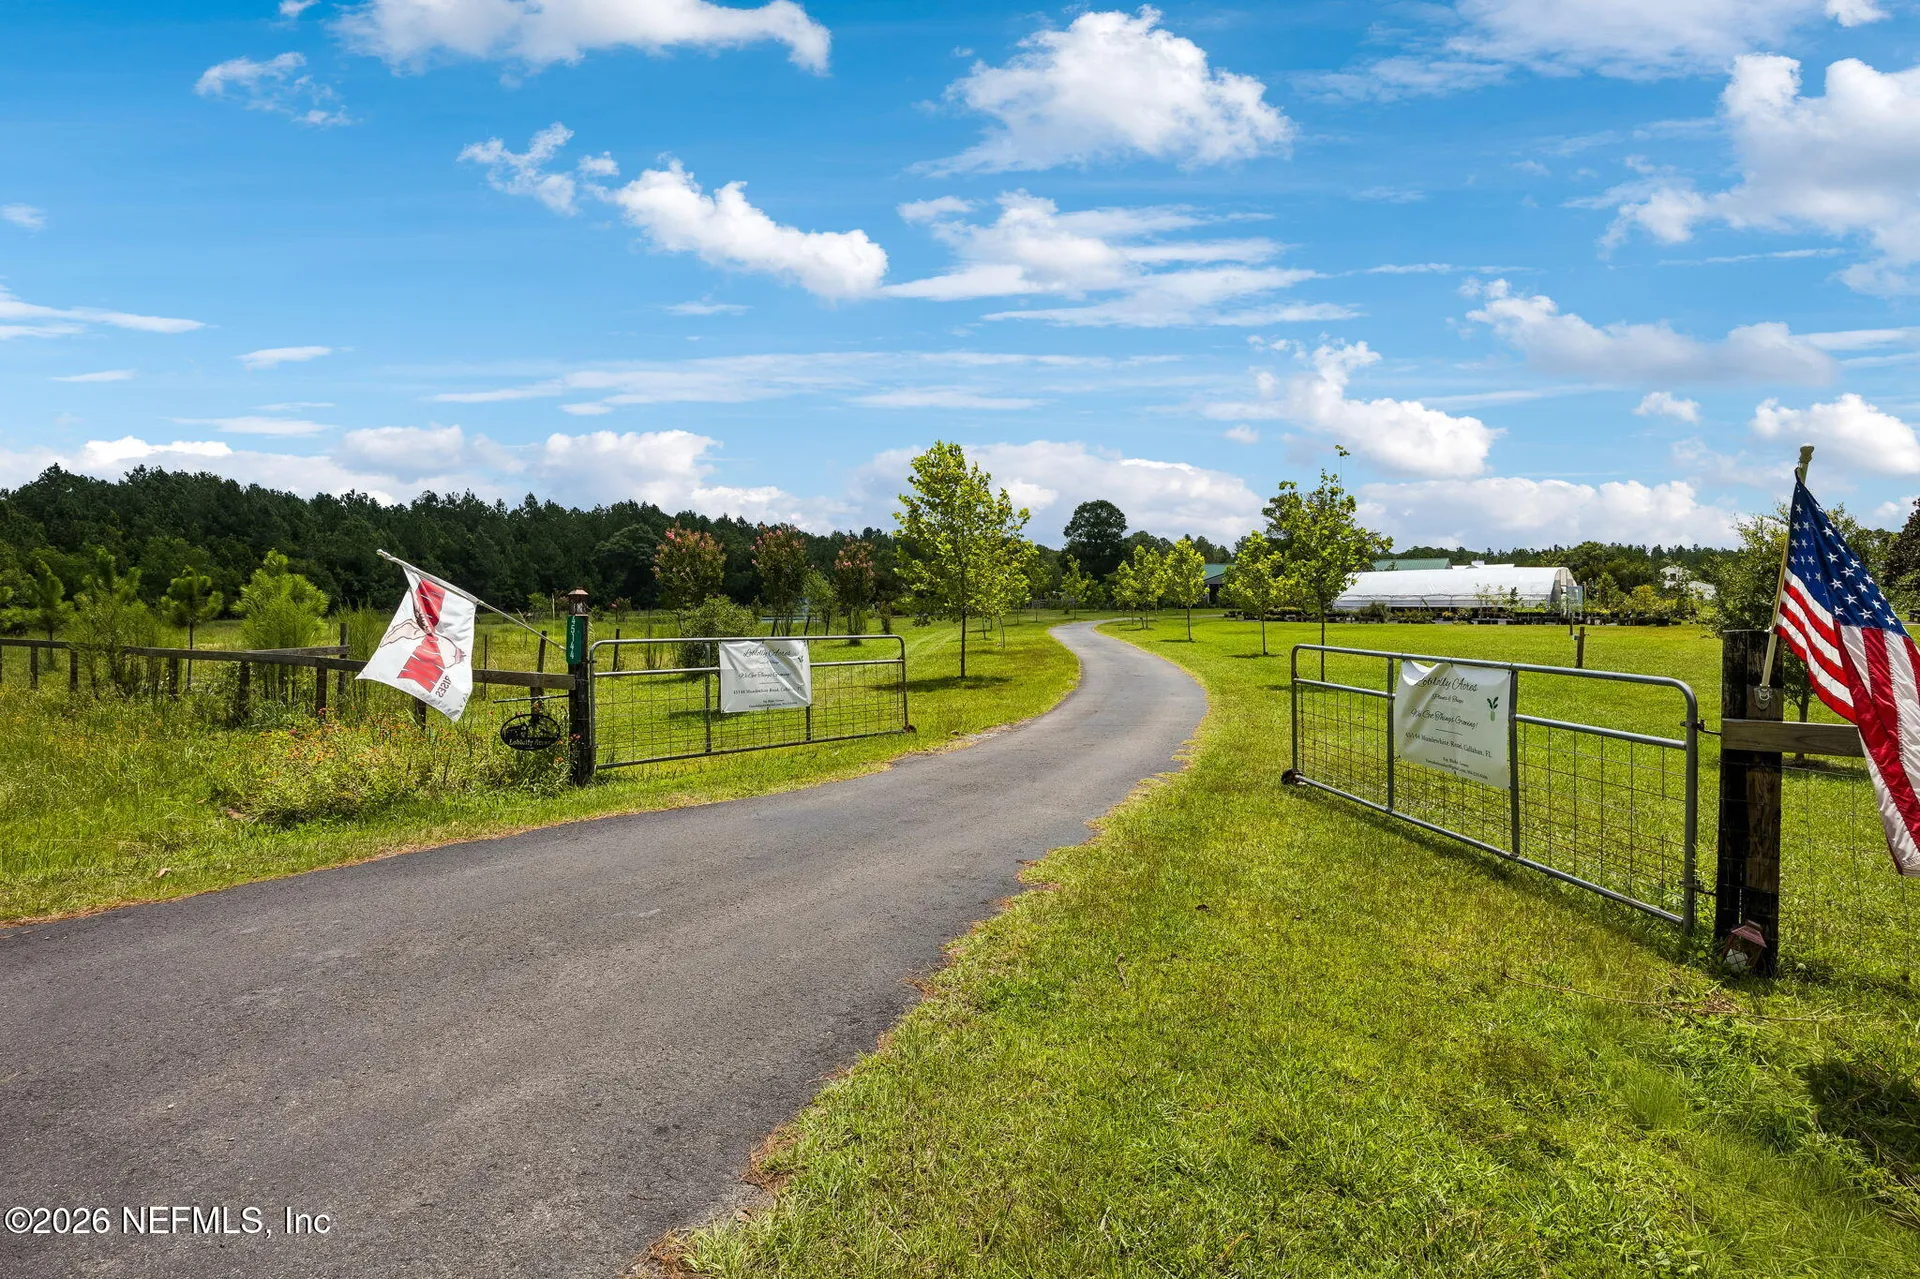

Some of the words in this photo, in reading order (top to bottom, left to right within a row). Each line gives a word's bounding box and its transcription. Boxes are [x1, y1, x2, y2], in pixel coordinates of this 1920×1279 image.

[1452, 676, 1479, 692] Acres
[1435, 710, 1454, 723] Things
[1485, 749, 1493, 758] FL
